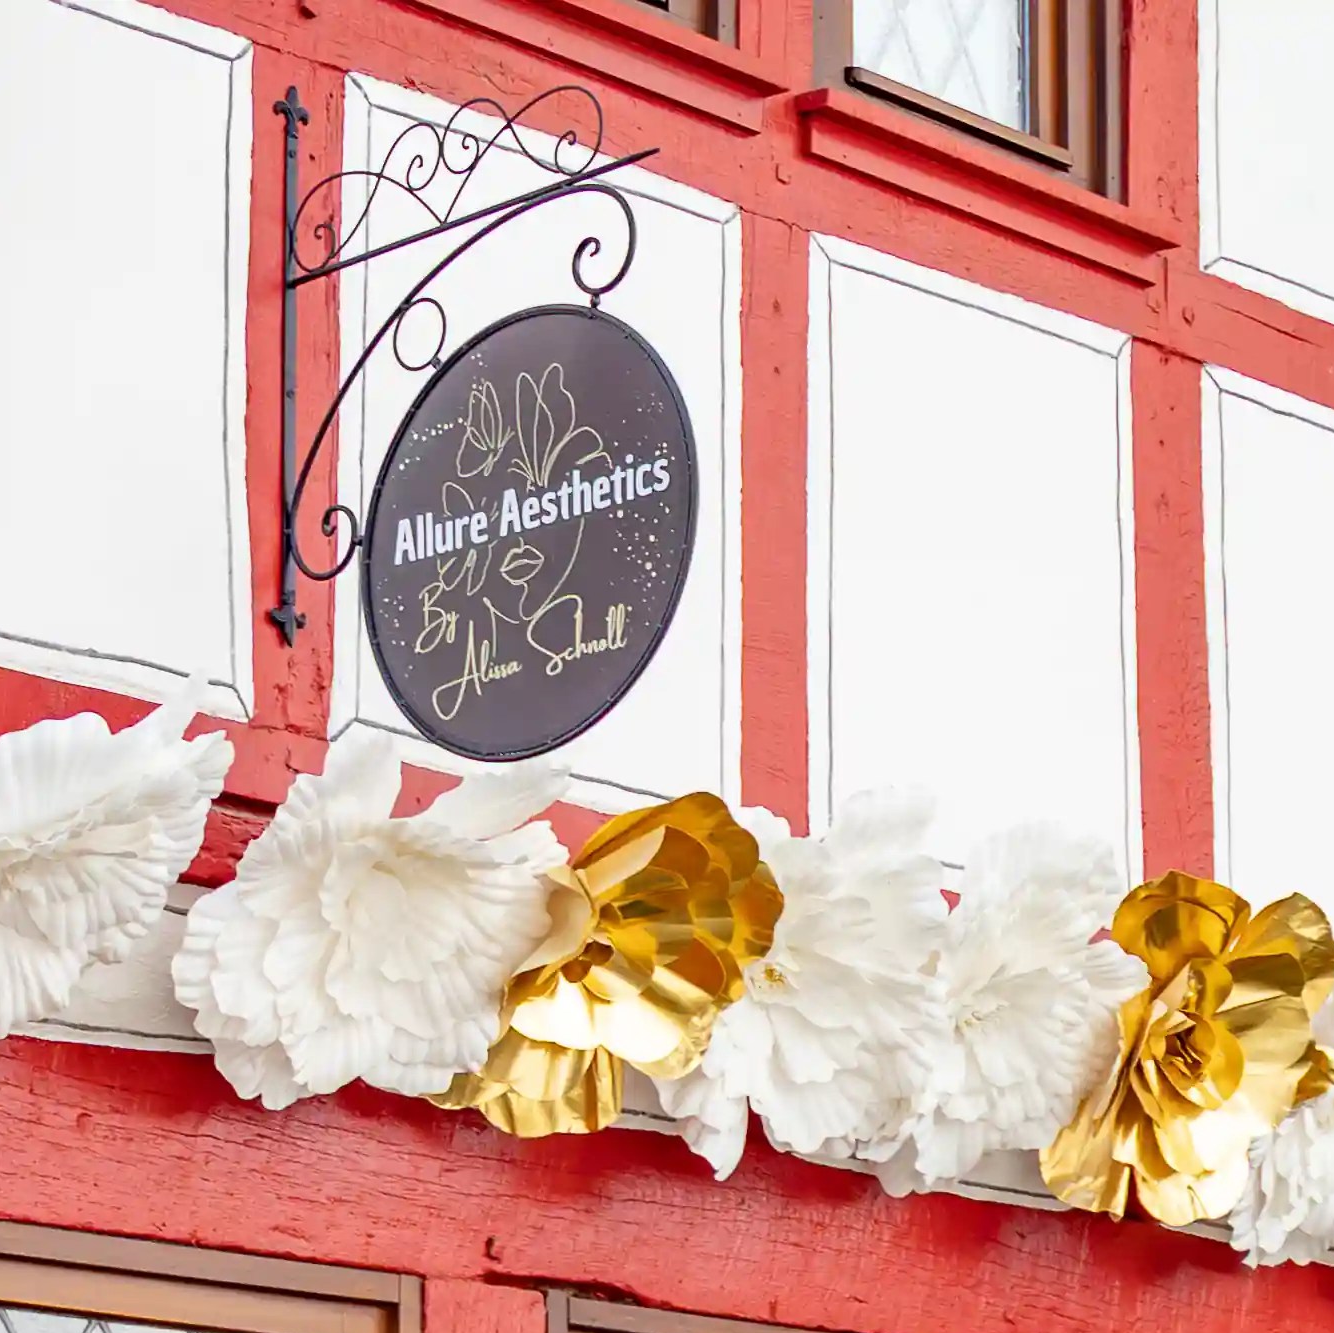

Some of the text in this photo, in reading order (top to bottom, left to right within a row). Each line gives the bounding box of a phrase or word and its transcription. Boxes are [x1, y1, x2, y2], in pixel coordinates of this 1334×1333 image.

[394, 453, 670, 565] Allure Aesthetics
[414, 582, 458, 653] By
[432, 620, 522, 720] Alissa
